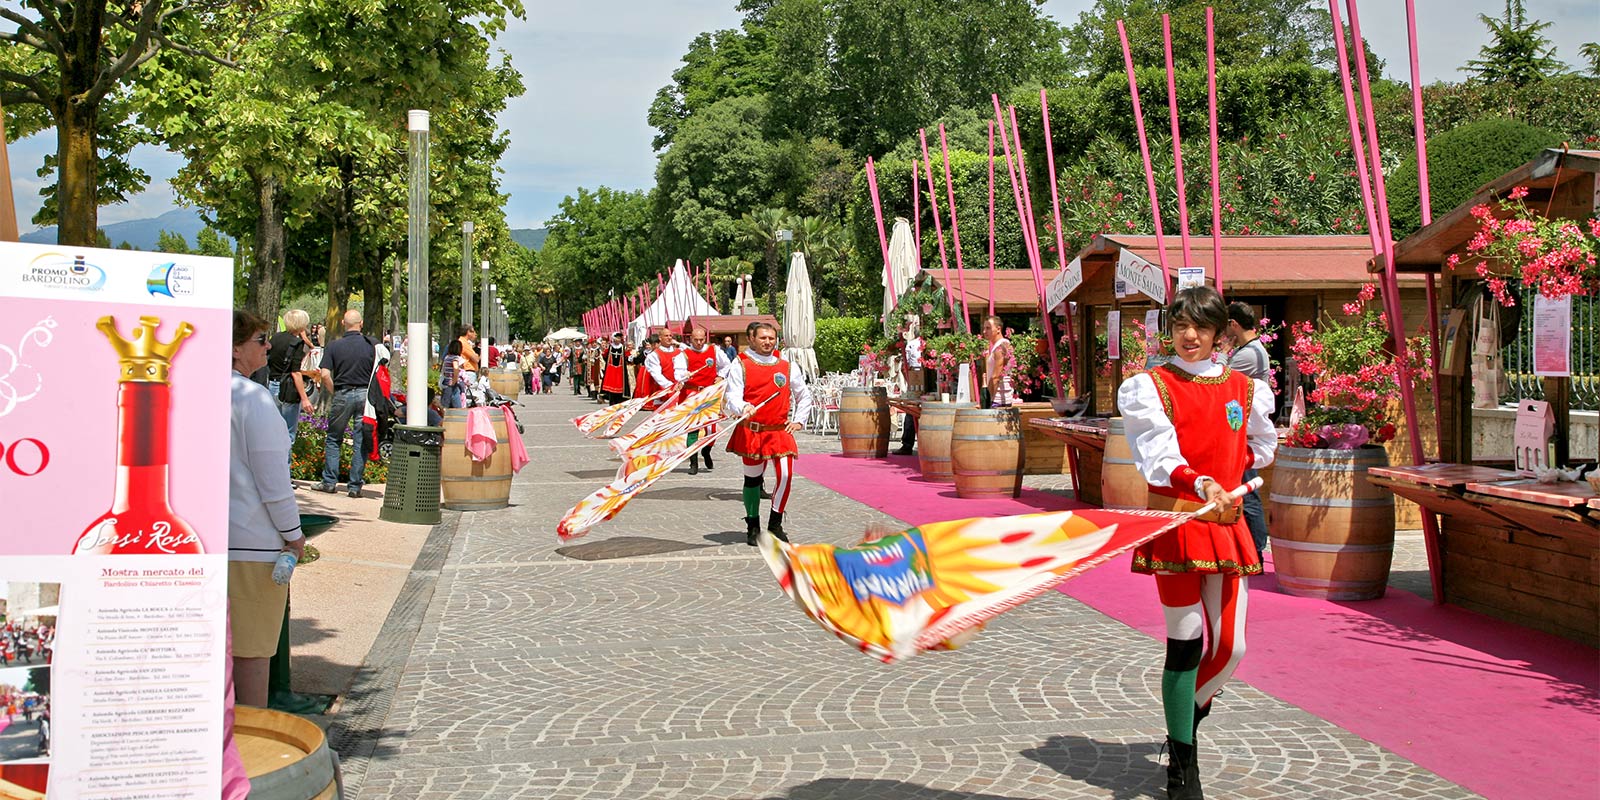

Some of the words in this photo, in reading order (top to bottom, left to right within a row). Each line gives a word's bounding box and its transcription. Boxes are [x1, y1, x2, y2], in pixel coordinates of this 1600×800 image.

[22, 273, 90, 285] BARDOLINO
[32, 267, 68, 276] PROMO
[1047, 287, 1065, 307] MONTE
[1063, 270, 1082, 295] SALINE
[1119, 263, 1143, 288] MONTE
[1142, 274, 1165, 301] SALINE
[0, 438, 50, 477] O
[144, 520, 199, 554] Rosa
[101, 568, 139, 577] Mostra
[142, 568, 185, 577] mercato
[188, 567, 204, 576] del
